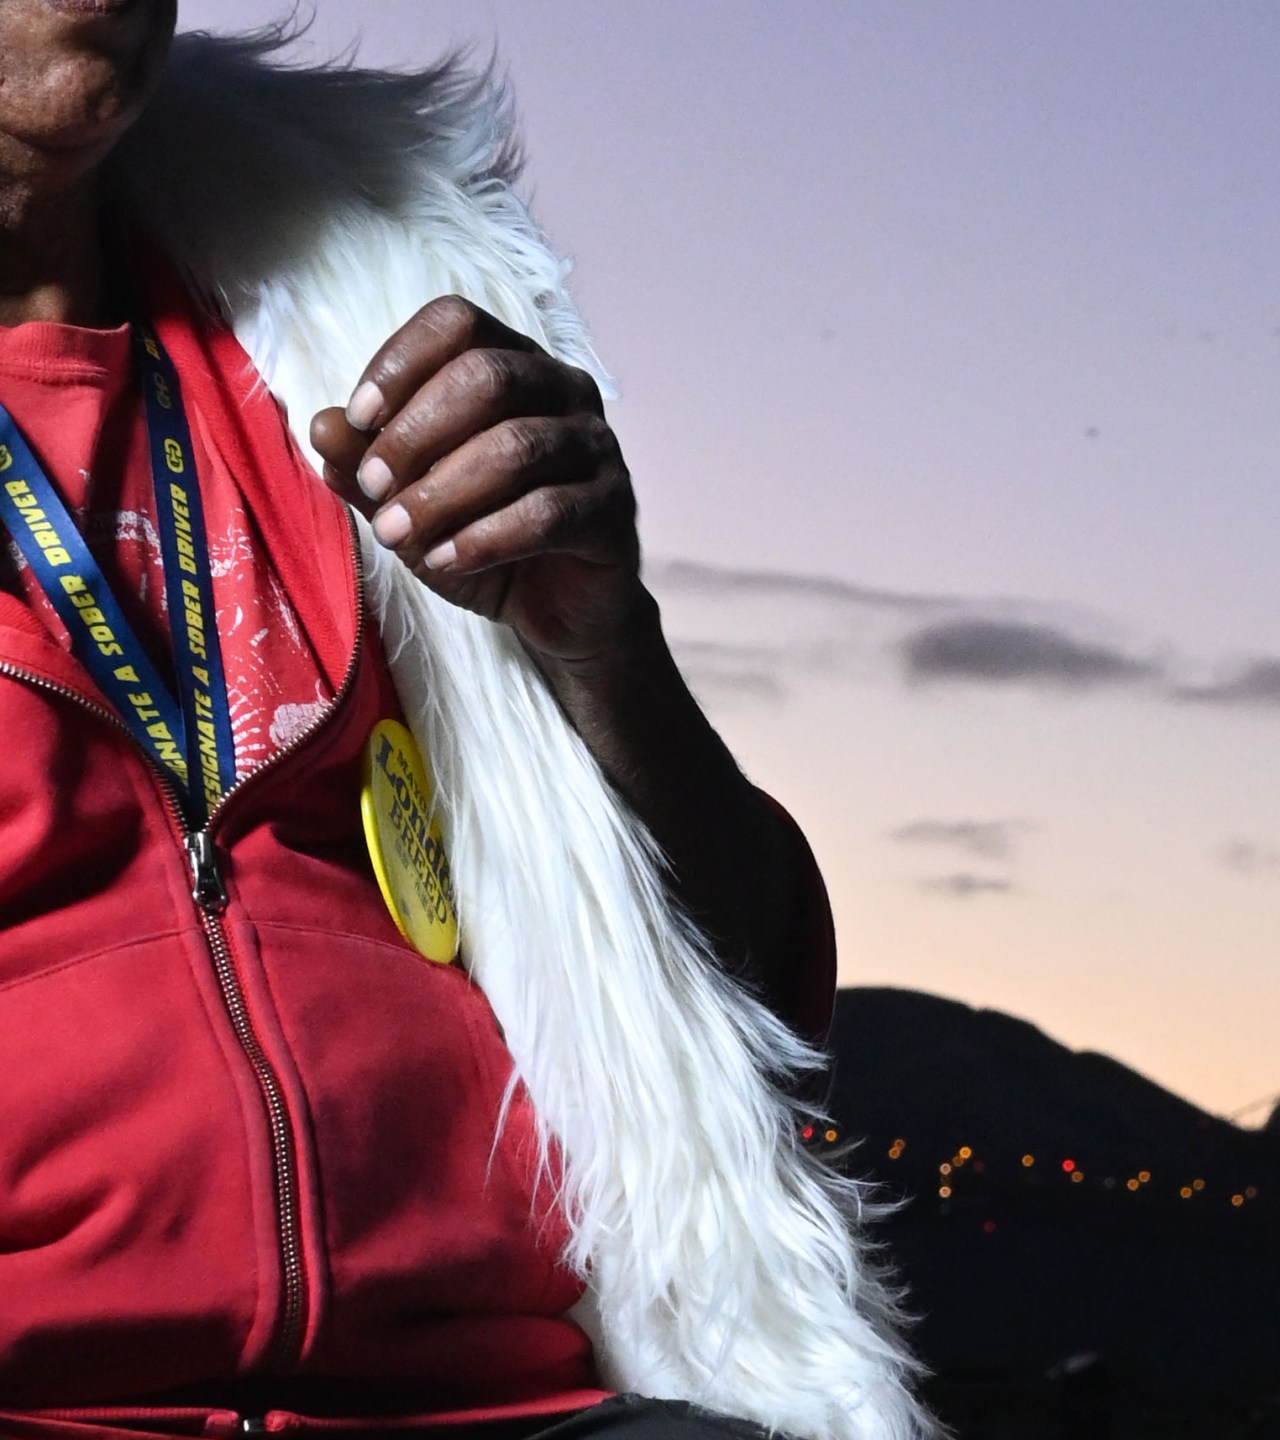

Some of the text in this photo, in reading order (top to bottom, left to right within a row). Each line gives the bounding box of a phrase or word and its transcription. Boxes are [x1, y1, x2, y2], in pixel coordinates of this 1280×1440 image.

[4, 479, 72, 567] DRIVER
[170, 483, 197, 575] DRIVER
[59, 574, 124, 657] SOBER
[181, 579, 207, 660] SOBER
[113, 665, 140, 683] A
[192, 665, 210, 687] A
[398, 748, 429, 818] MAYO
[376, 733, 458, 926] Londo
[388, 795, 448, 924] BREED
